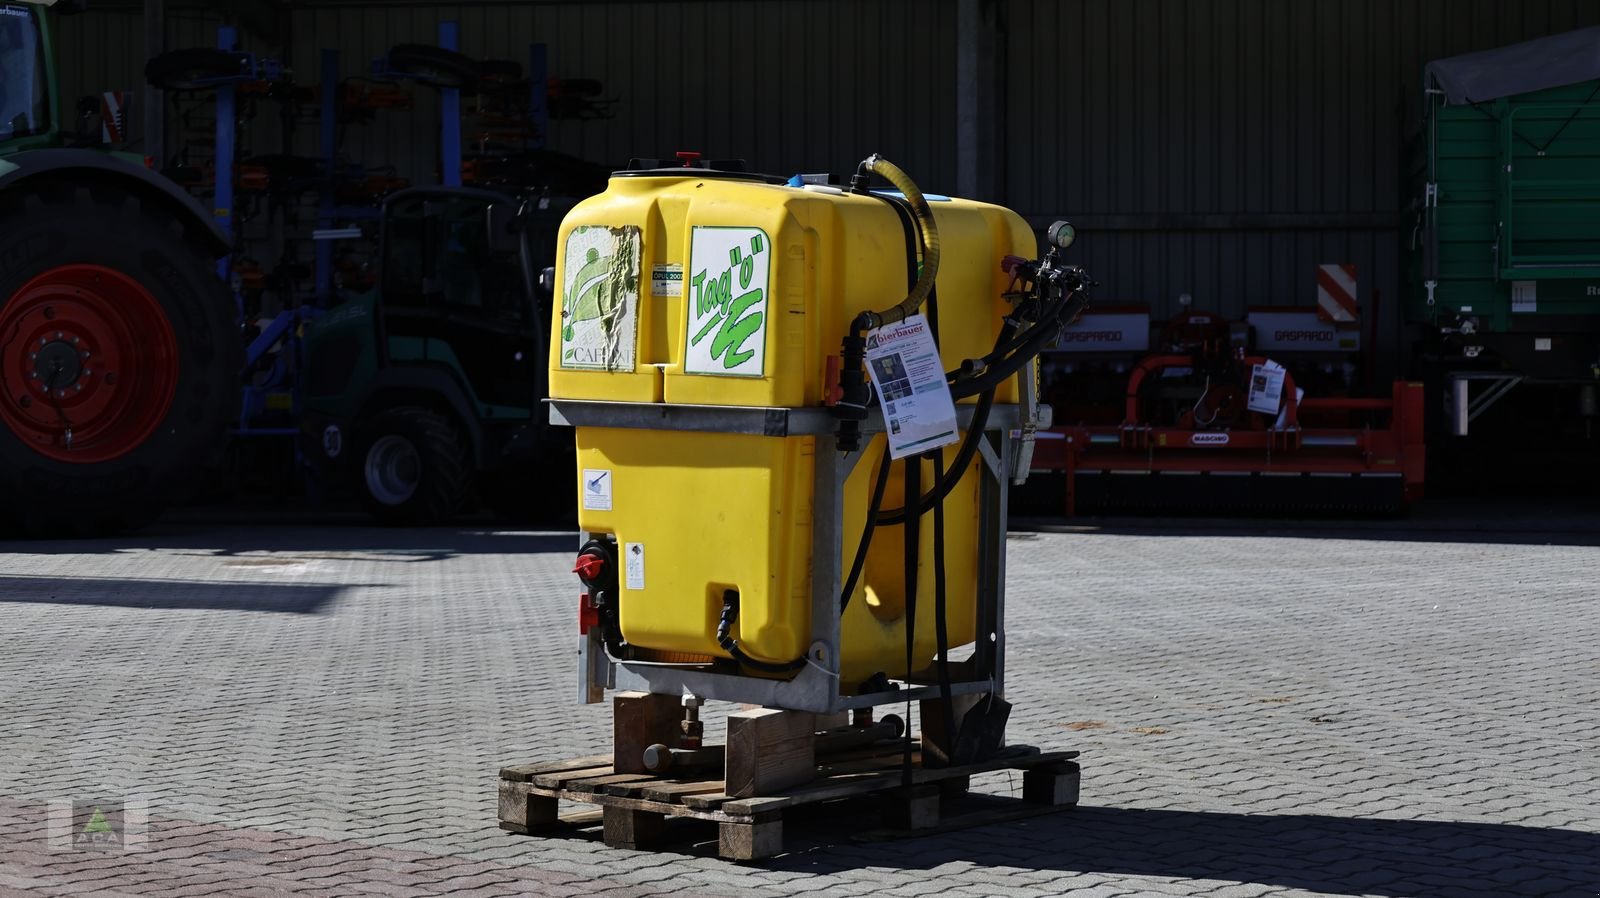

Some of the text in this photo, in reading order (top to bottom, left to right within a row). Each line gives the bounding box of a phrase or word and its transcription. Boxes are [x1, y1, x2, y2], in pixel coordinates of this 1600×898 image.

[876, 325, 924, 343] bierbauer
[1064, 331, 1122, 342] GASPARDO
[1274, 330, 1334, 341] GASPARDO
